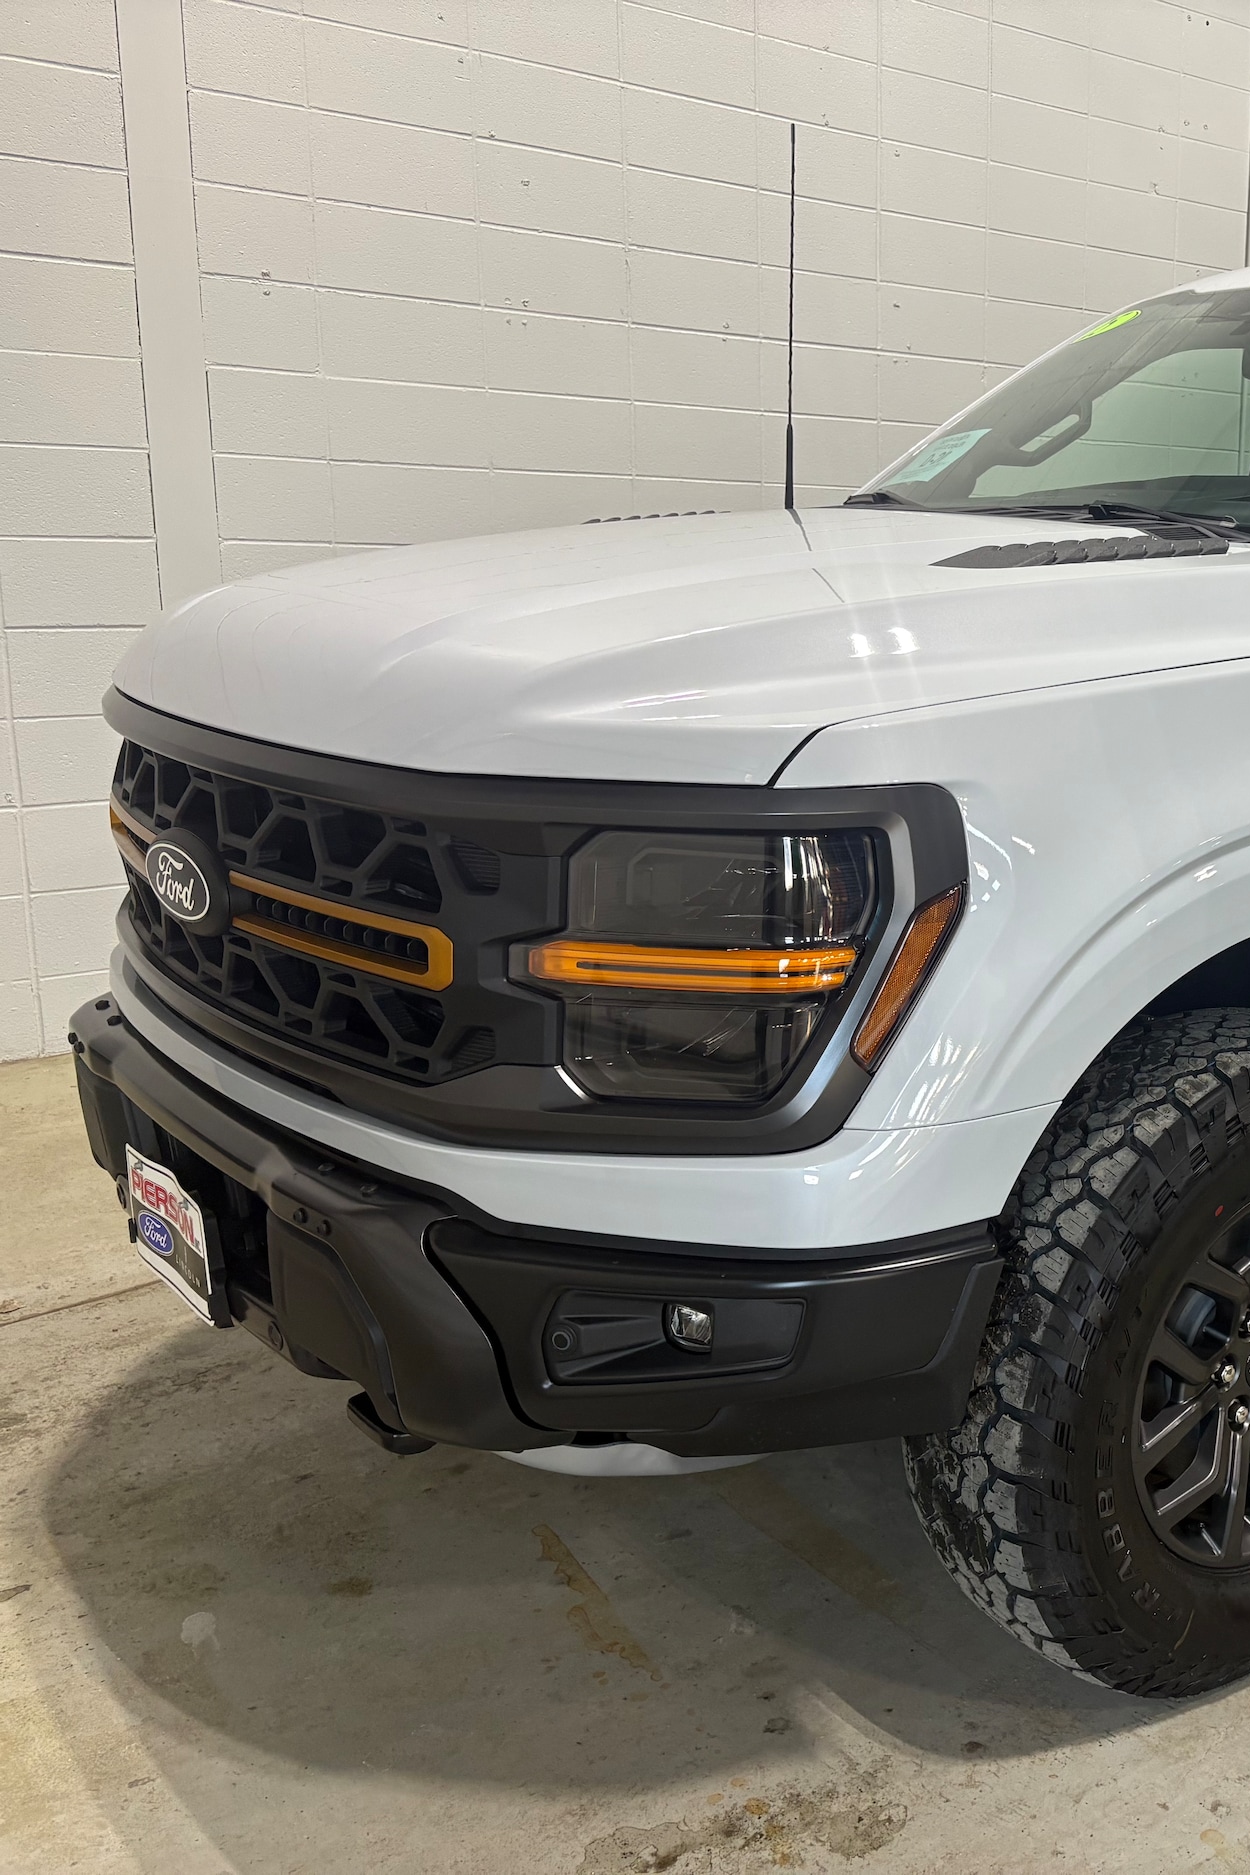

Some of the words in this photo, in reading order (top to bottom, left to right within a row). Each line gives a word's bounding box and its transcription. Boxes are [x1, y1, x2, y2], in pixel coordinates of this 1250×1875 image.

[156, 851, 195, 911] Ford
[132, 1168, 196, 1244] PIERSON
[144, 1217, 168, 1249] Ford
[175, 1254, 202, 1288] LINCOLN
[1096, 1398, 1182, 1625] RABBER
